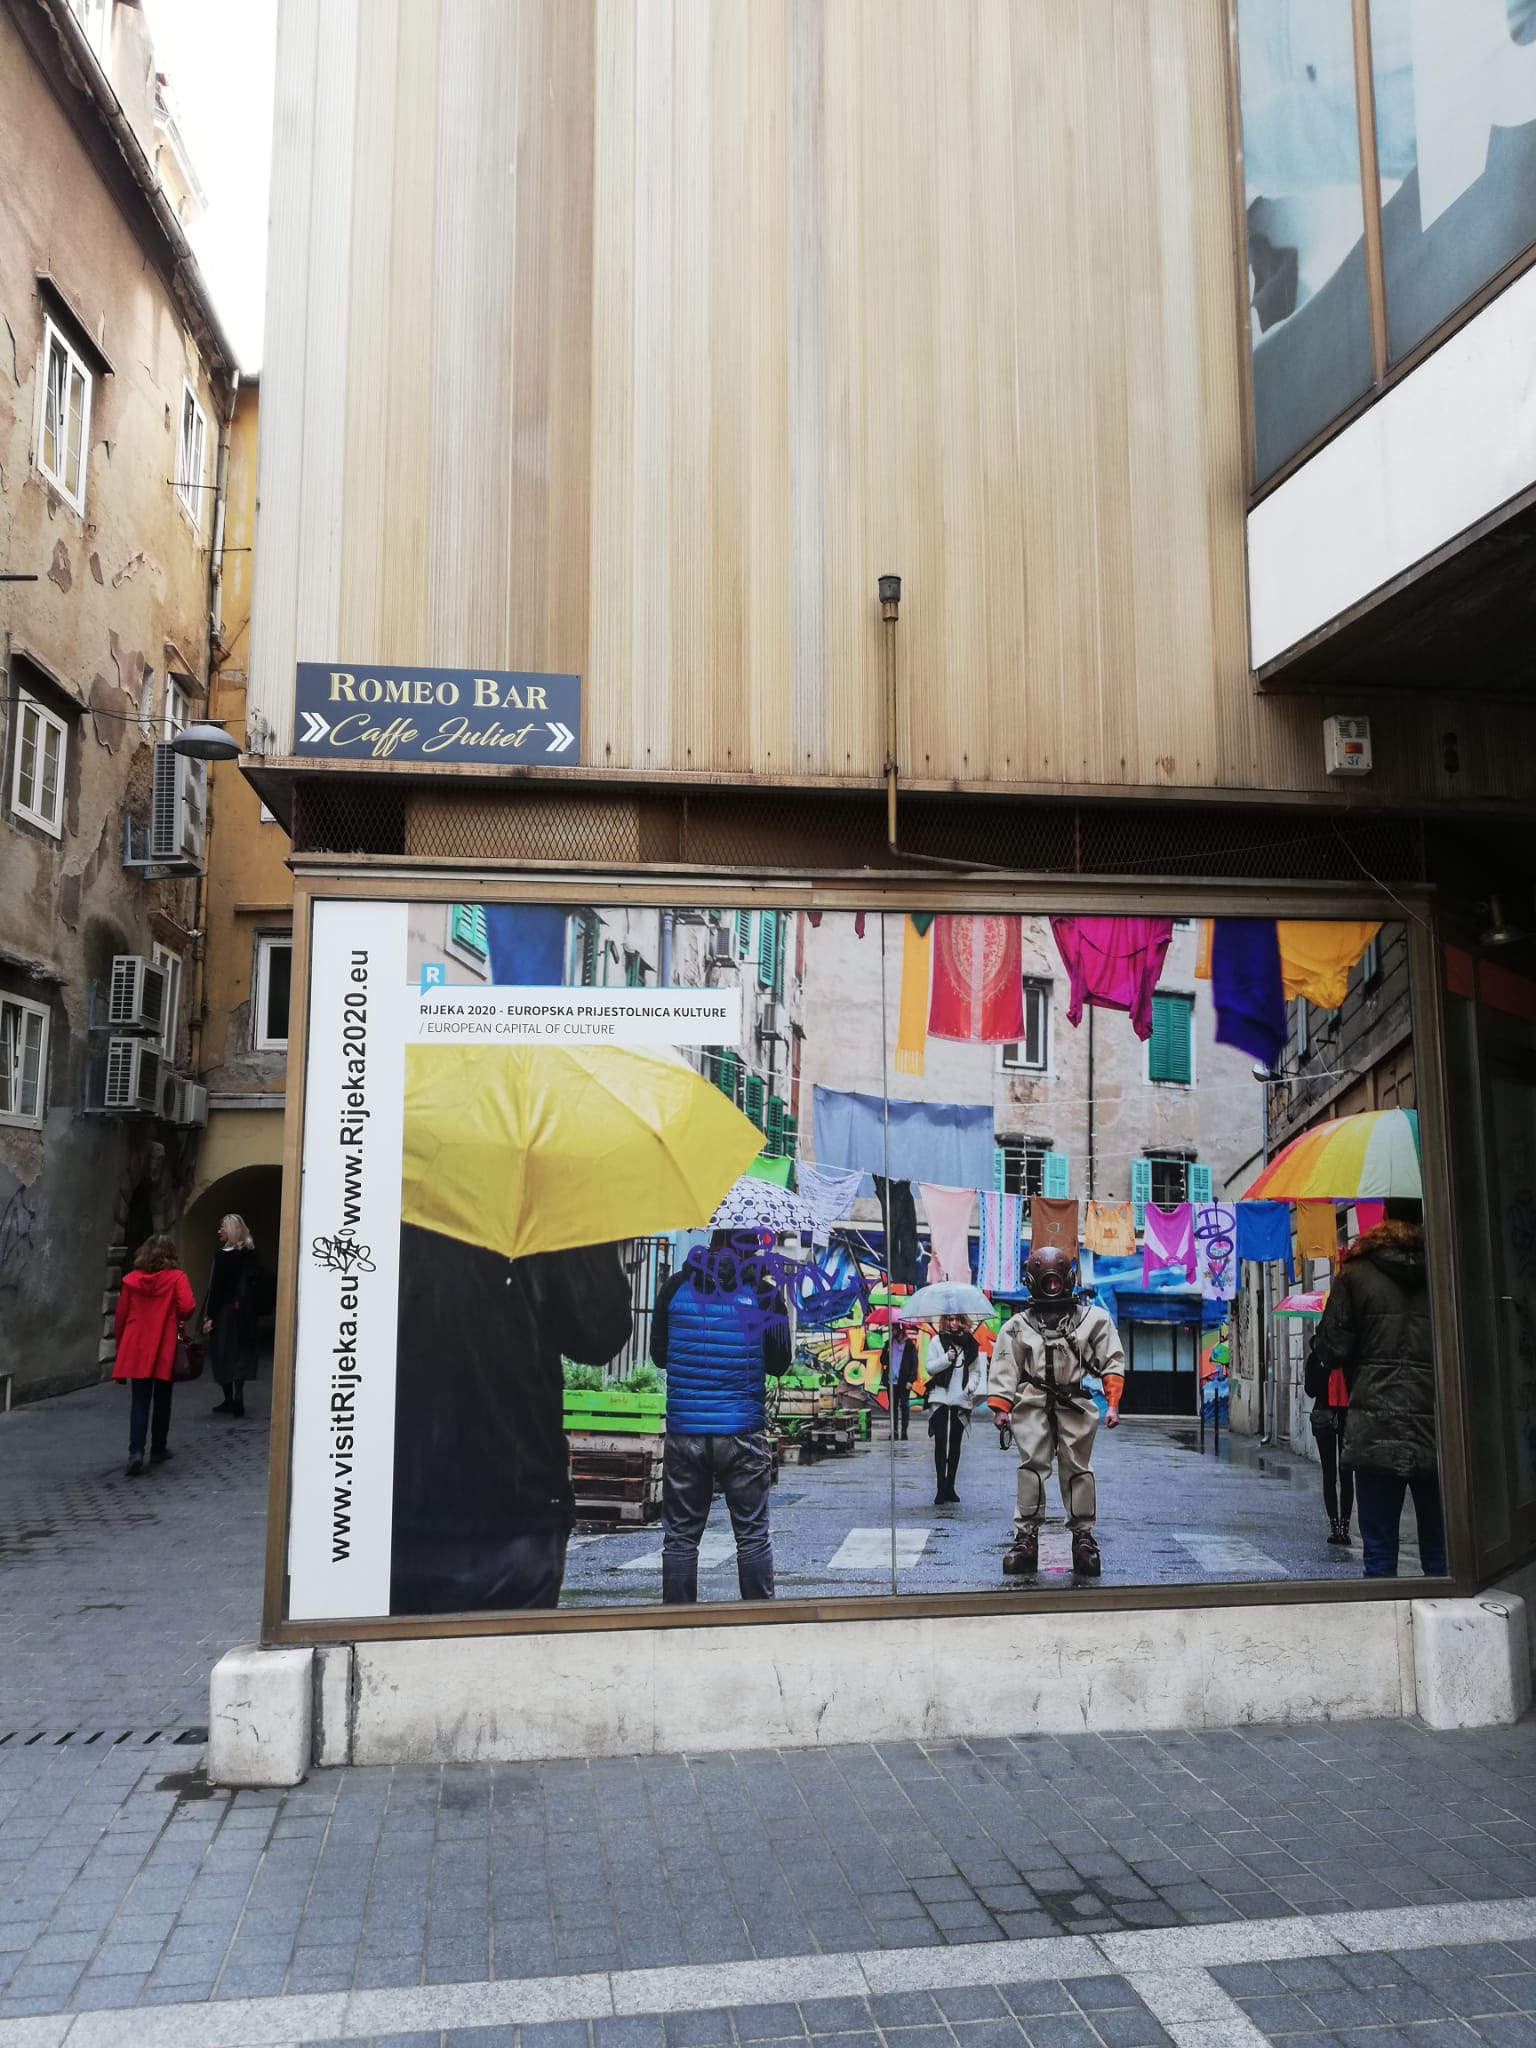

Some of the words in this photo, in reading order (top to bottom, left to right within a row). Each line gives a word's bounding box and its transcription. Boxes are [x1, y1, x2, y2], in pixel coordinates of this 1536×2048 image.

[329, 713, 419, 757] Caffe
[421, 716, 549, 753] Juliet
[419, 1004, 465, 1016] RIJEKA
[467, 1005, 497, 1016] 2020
[507, 1005, 574, 1017] EUROPSKA
[577, 1006, 671, 1018] PRIJESTOLNICA
[673, 1007, 727, 1018] KULTURE
[427, 1022, 493, 1034] EUROPEAN
[495, 1022, 543, 1035] CAPITAL
[545, 1023, 561, 1034] OF
[563, 1023, 616, 1035] CULTURE
[340, 951, 370, 1226] www.Rijeka2020.eu
[330, 1277, 361, 1562] www.visitRijeka.eu
